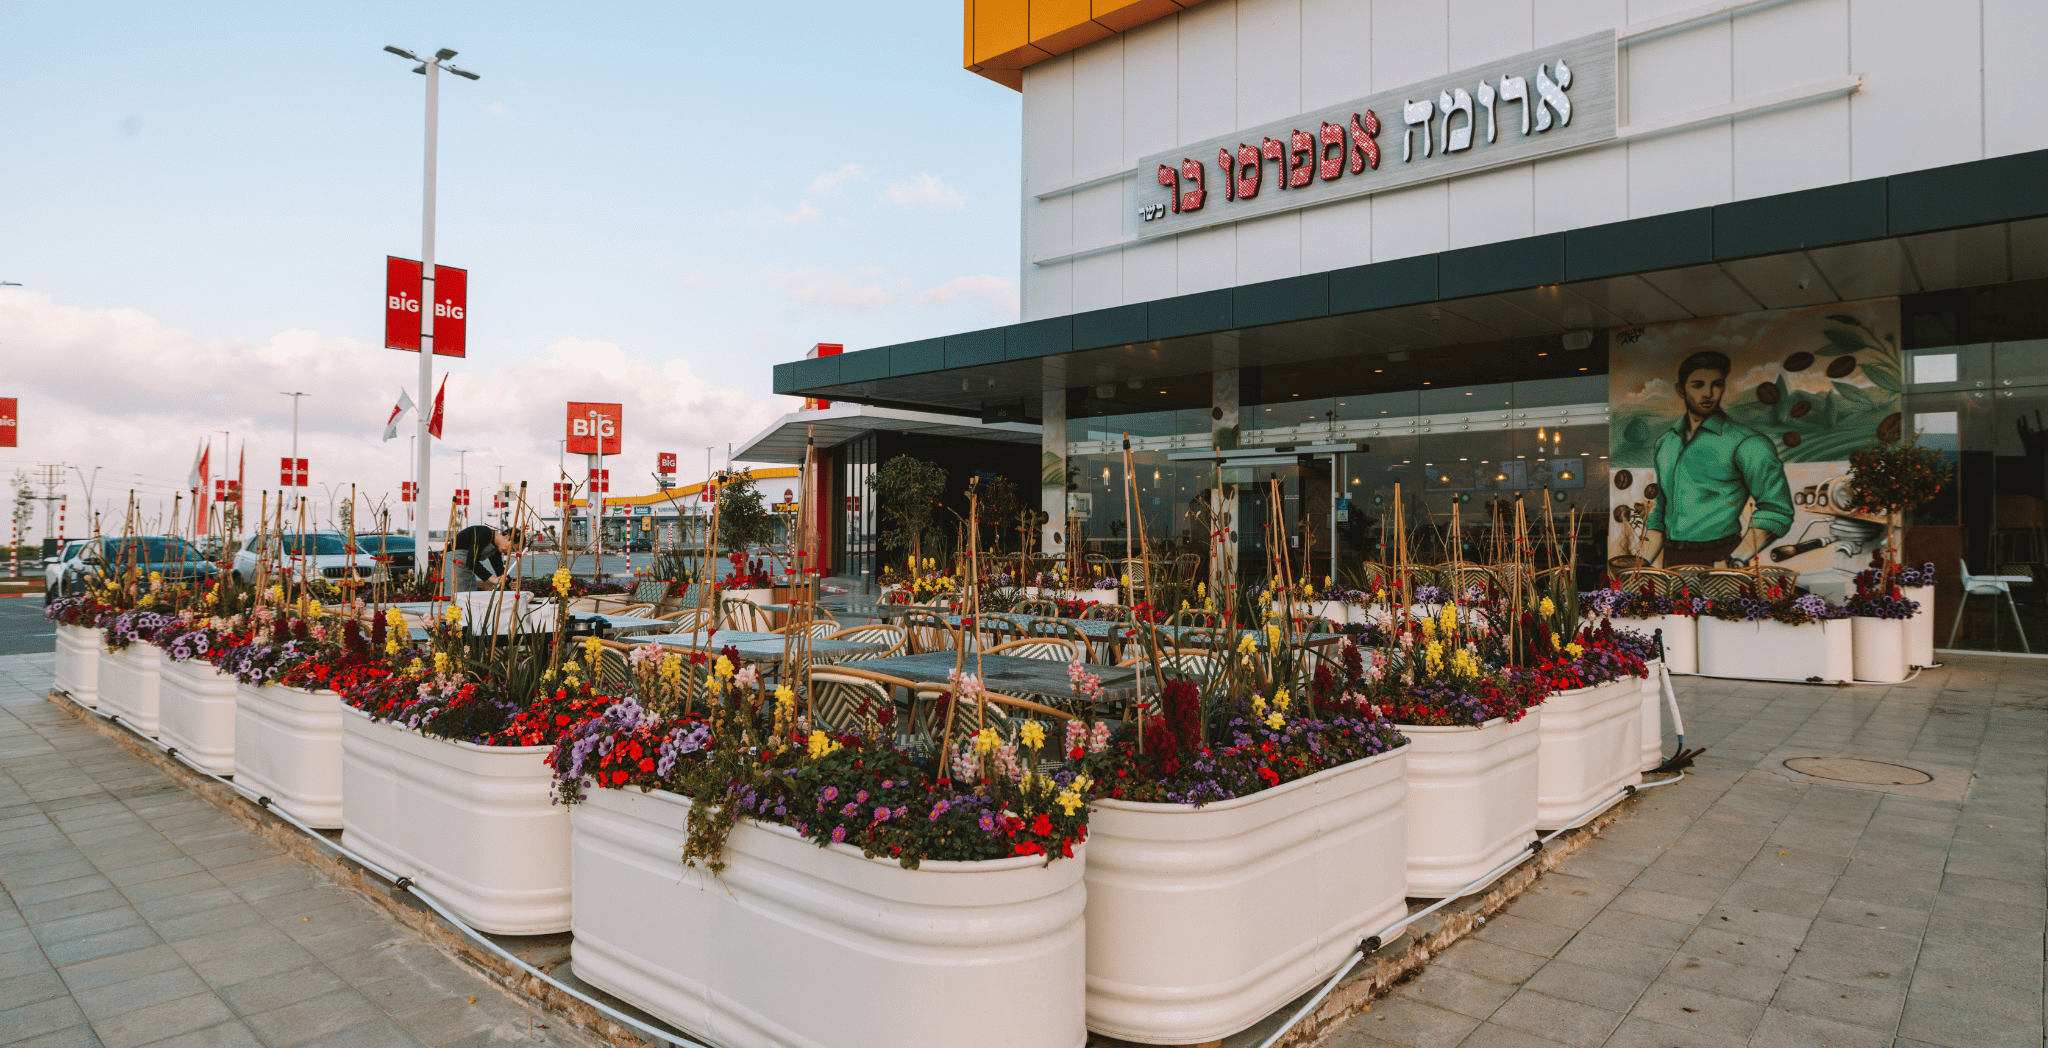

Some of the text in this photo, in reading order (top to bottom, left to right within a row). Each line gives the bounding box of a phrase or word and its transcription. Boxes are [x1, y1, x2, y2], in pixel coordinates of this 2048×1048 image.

[1158, 58, 1573, 214] ארומה אספרסו בר
[1138, 203, 1165, 221] כשר
